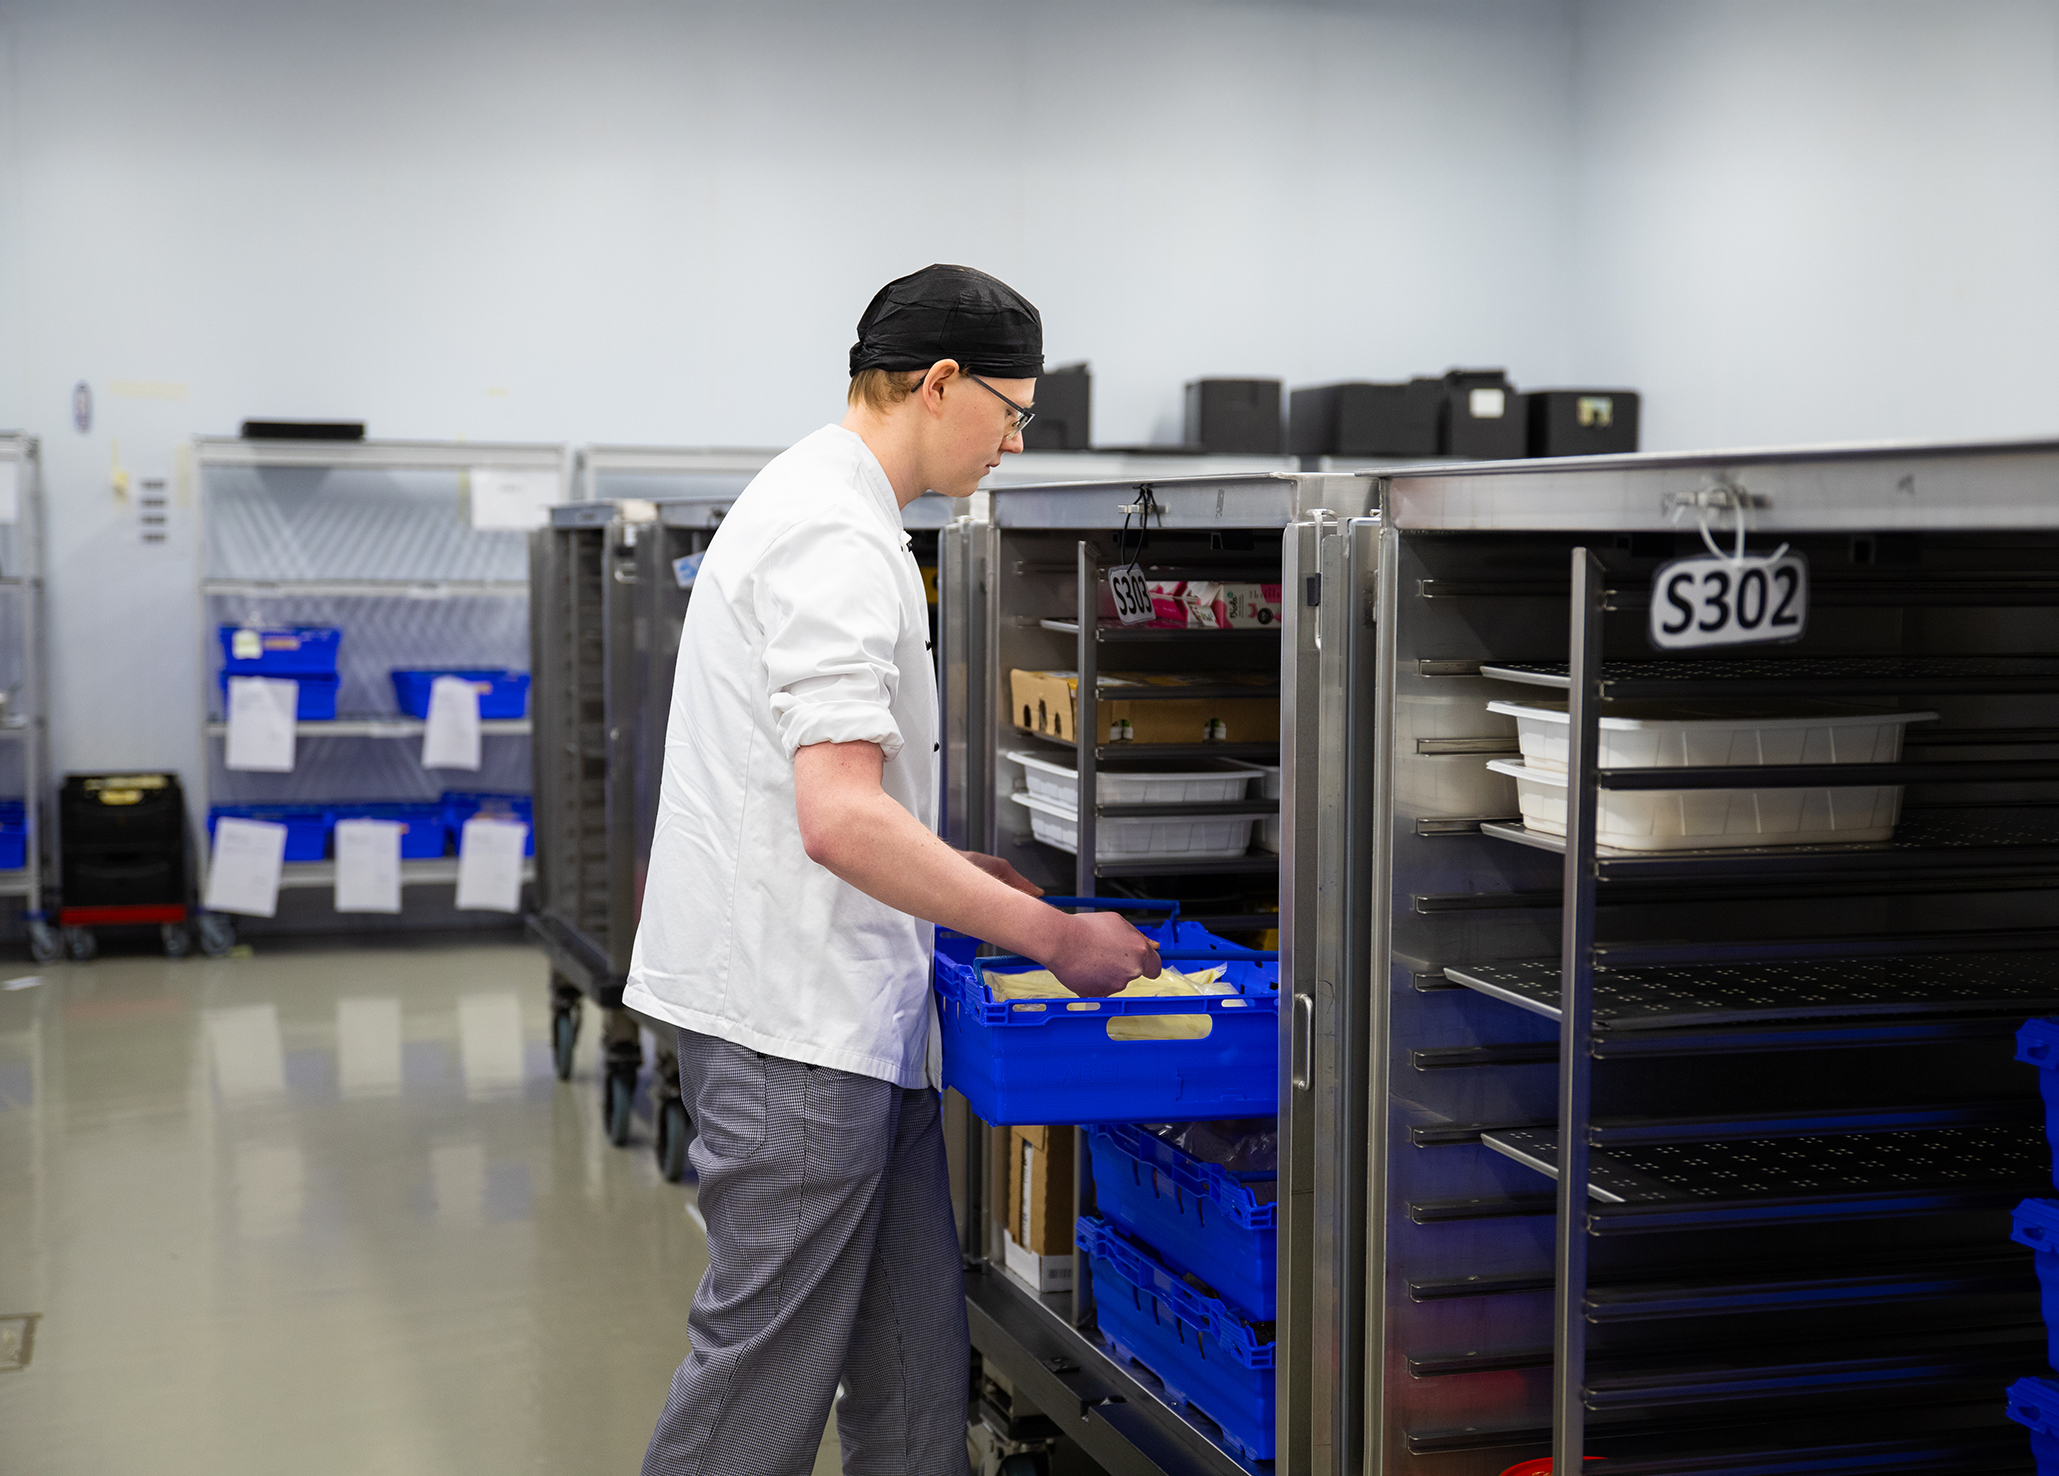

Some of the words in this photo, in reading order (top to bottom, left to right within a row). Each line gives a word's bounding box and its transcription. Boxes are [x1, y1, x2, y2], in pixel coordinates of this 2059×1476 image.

[1112, 575, 1153, 616] S303
[1228, 595, 1238, 619] Biola
[1661, 566, 1798, 635] S302
[1042, 1062, 1129, 1087] LABEL
